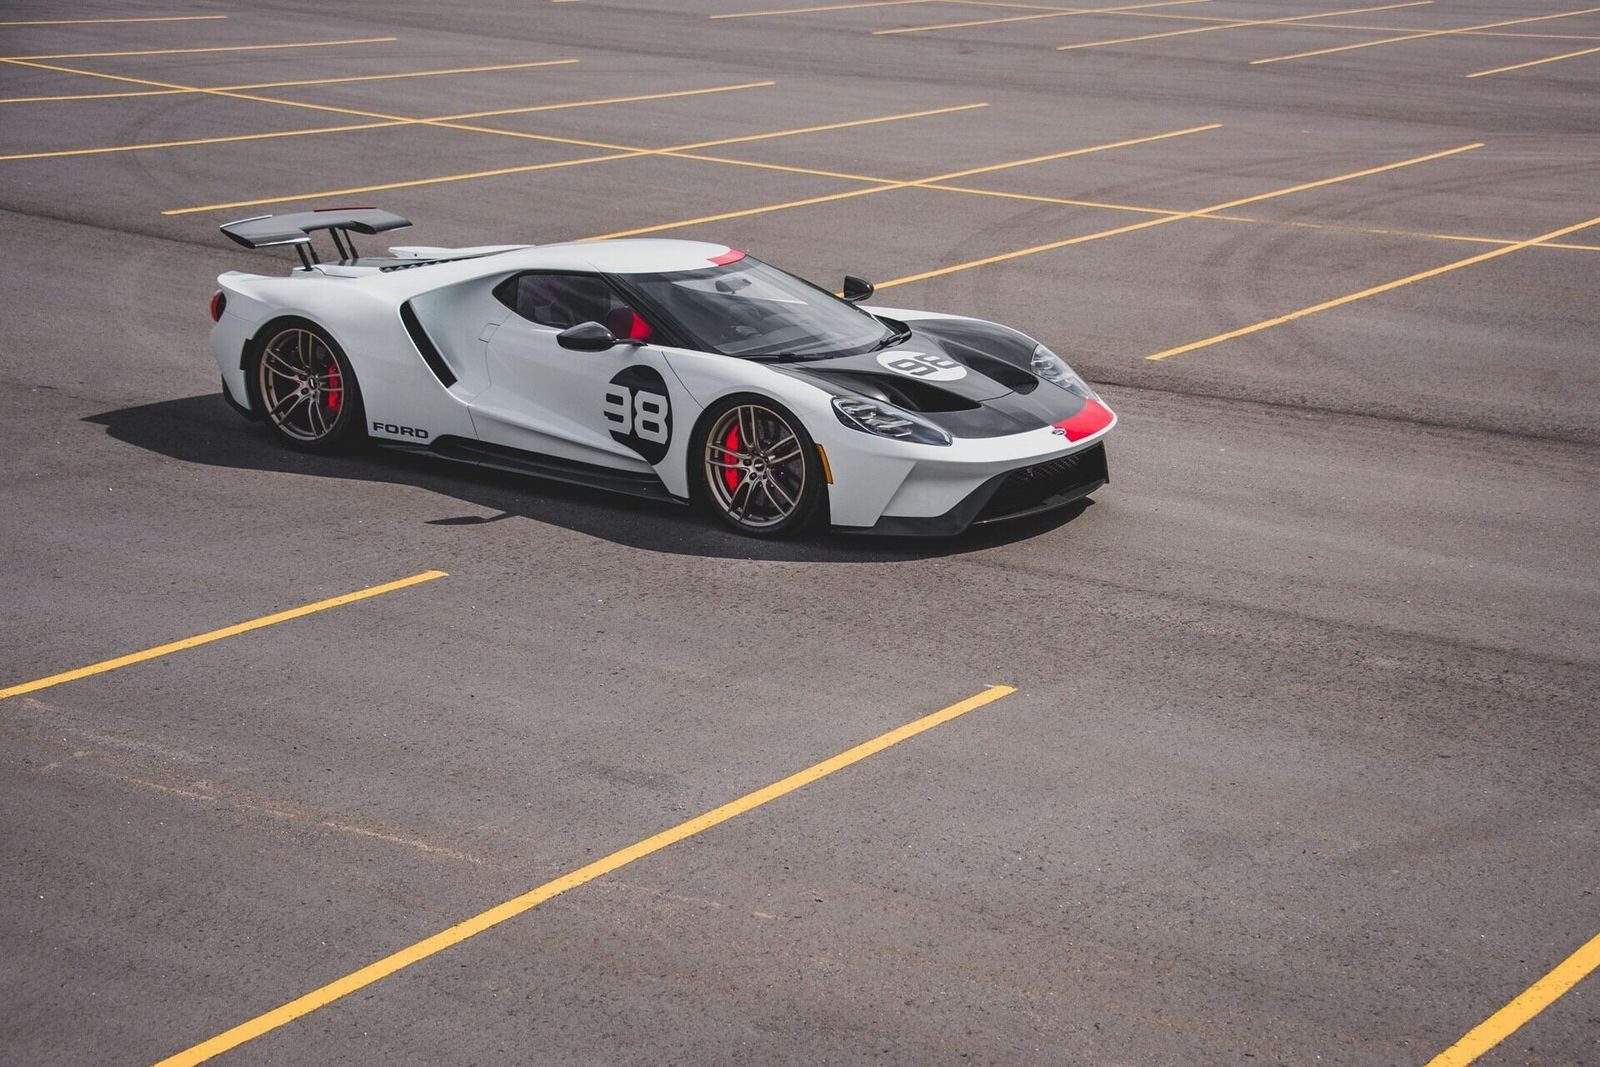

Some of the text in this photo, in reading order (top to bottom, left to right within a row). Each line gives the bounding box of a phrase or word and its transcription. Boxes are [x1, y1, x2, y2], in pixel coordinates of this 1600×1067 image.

[887, 355, 961, 376] 98
[602, 383, 669, 445] 98
[373, 421, 429, 439] FORD
